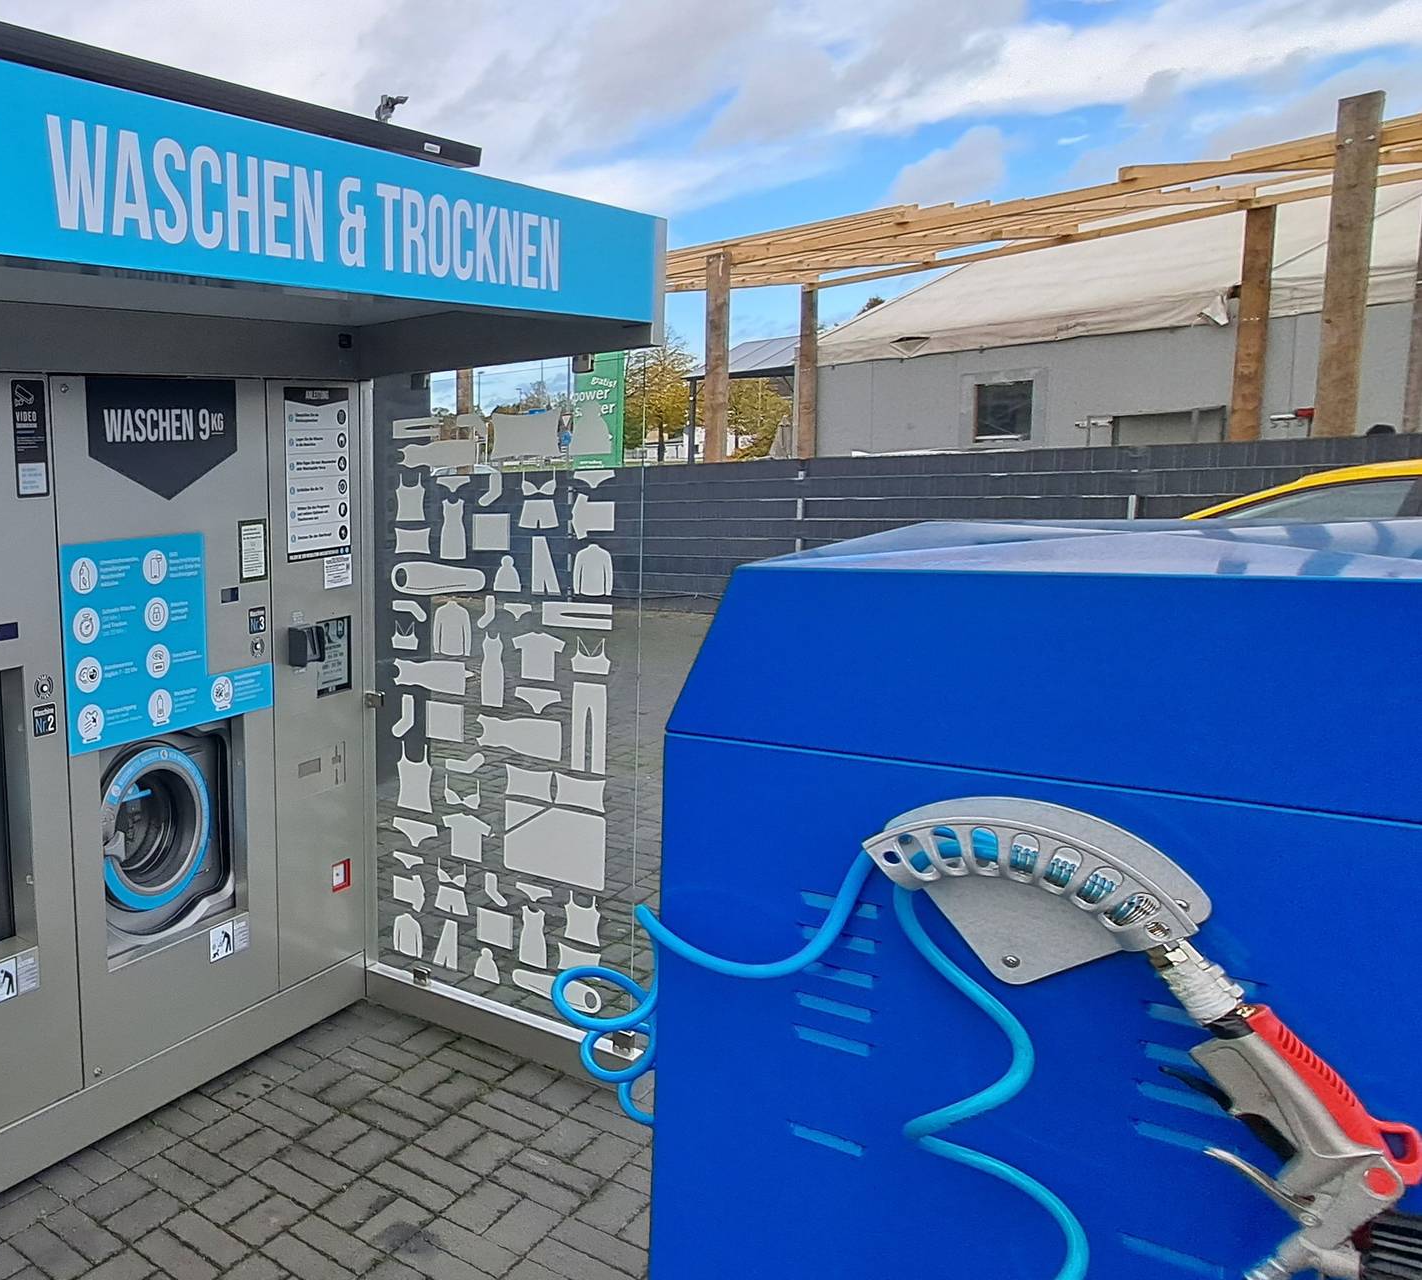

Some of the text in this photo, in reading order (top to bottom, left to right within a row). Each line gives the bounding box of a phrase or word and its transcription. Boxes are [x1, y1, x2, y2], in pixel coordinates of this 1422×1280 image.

[45, 113, 561, 292] WASCHEN & TROCKNEN
[591, 376, 617, 389] gratis!
[15, 411, 37, 422] VIDEO
[103, 408, 194, 442] WASCHEN
